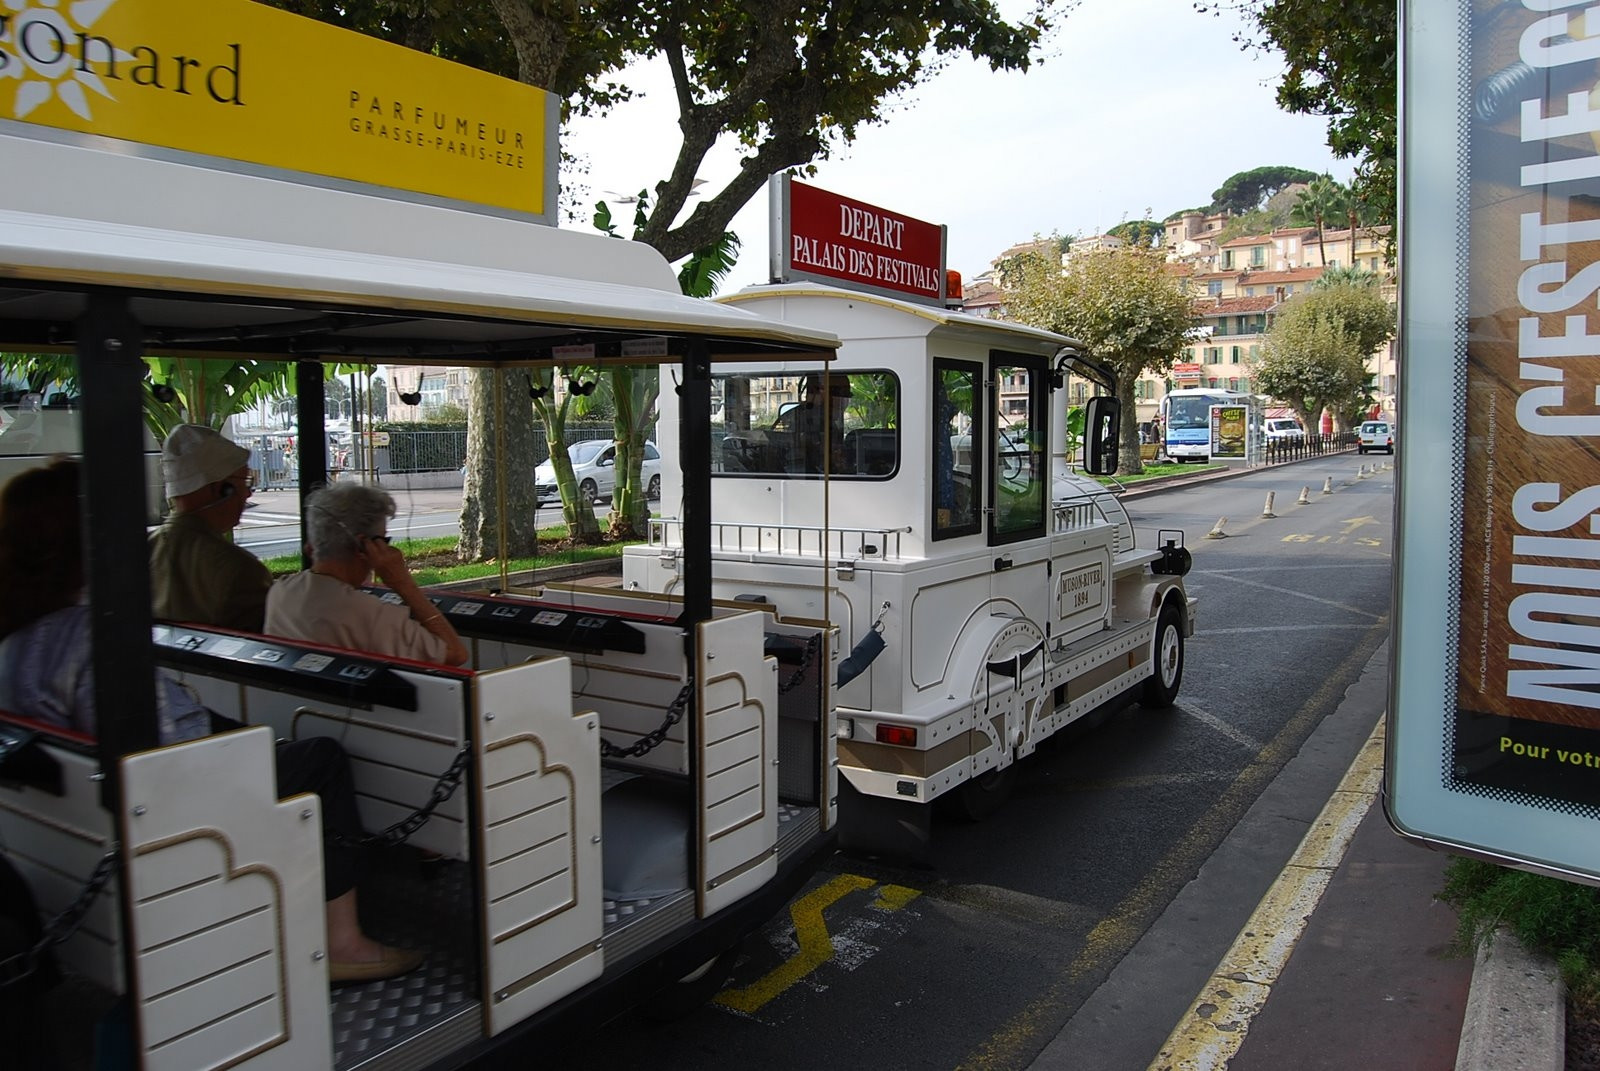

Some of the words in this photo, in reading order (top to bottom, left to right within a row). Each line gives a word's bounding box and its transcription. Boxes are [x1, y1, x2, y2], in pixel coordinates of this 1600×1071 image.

[349, 90, 525, 150] PARFUMEUR
[349, 117, 525, 169] GRASSE-PARIS-EZE
[840, 204, 905, 250] DEPART
[792, 234, 846, 272] PALAIS
[848, 248, 874, 279] DES
[876, 254, 939, 292] FESTIVALS
[1062, 569, 1100, 594] MUSON-RIVER
[1074, 590, 1089, 607] 1894
[1479, 655, 1487, 673] Quick
[1486, 505, 1494, 528] Bobigny
[1500, 737, 1549, 759] Pour
